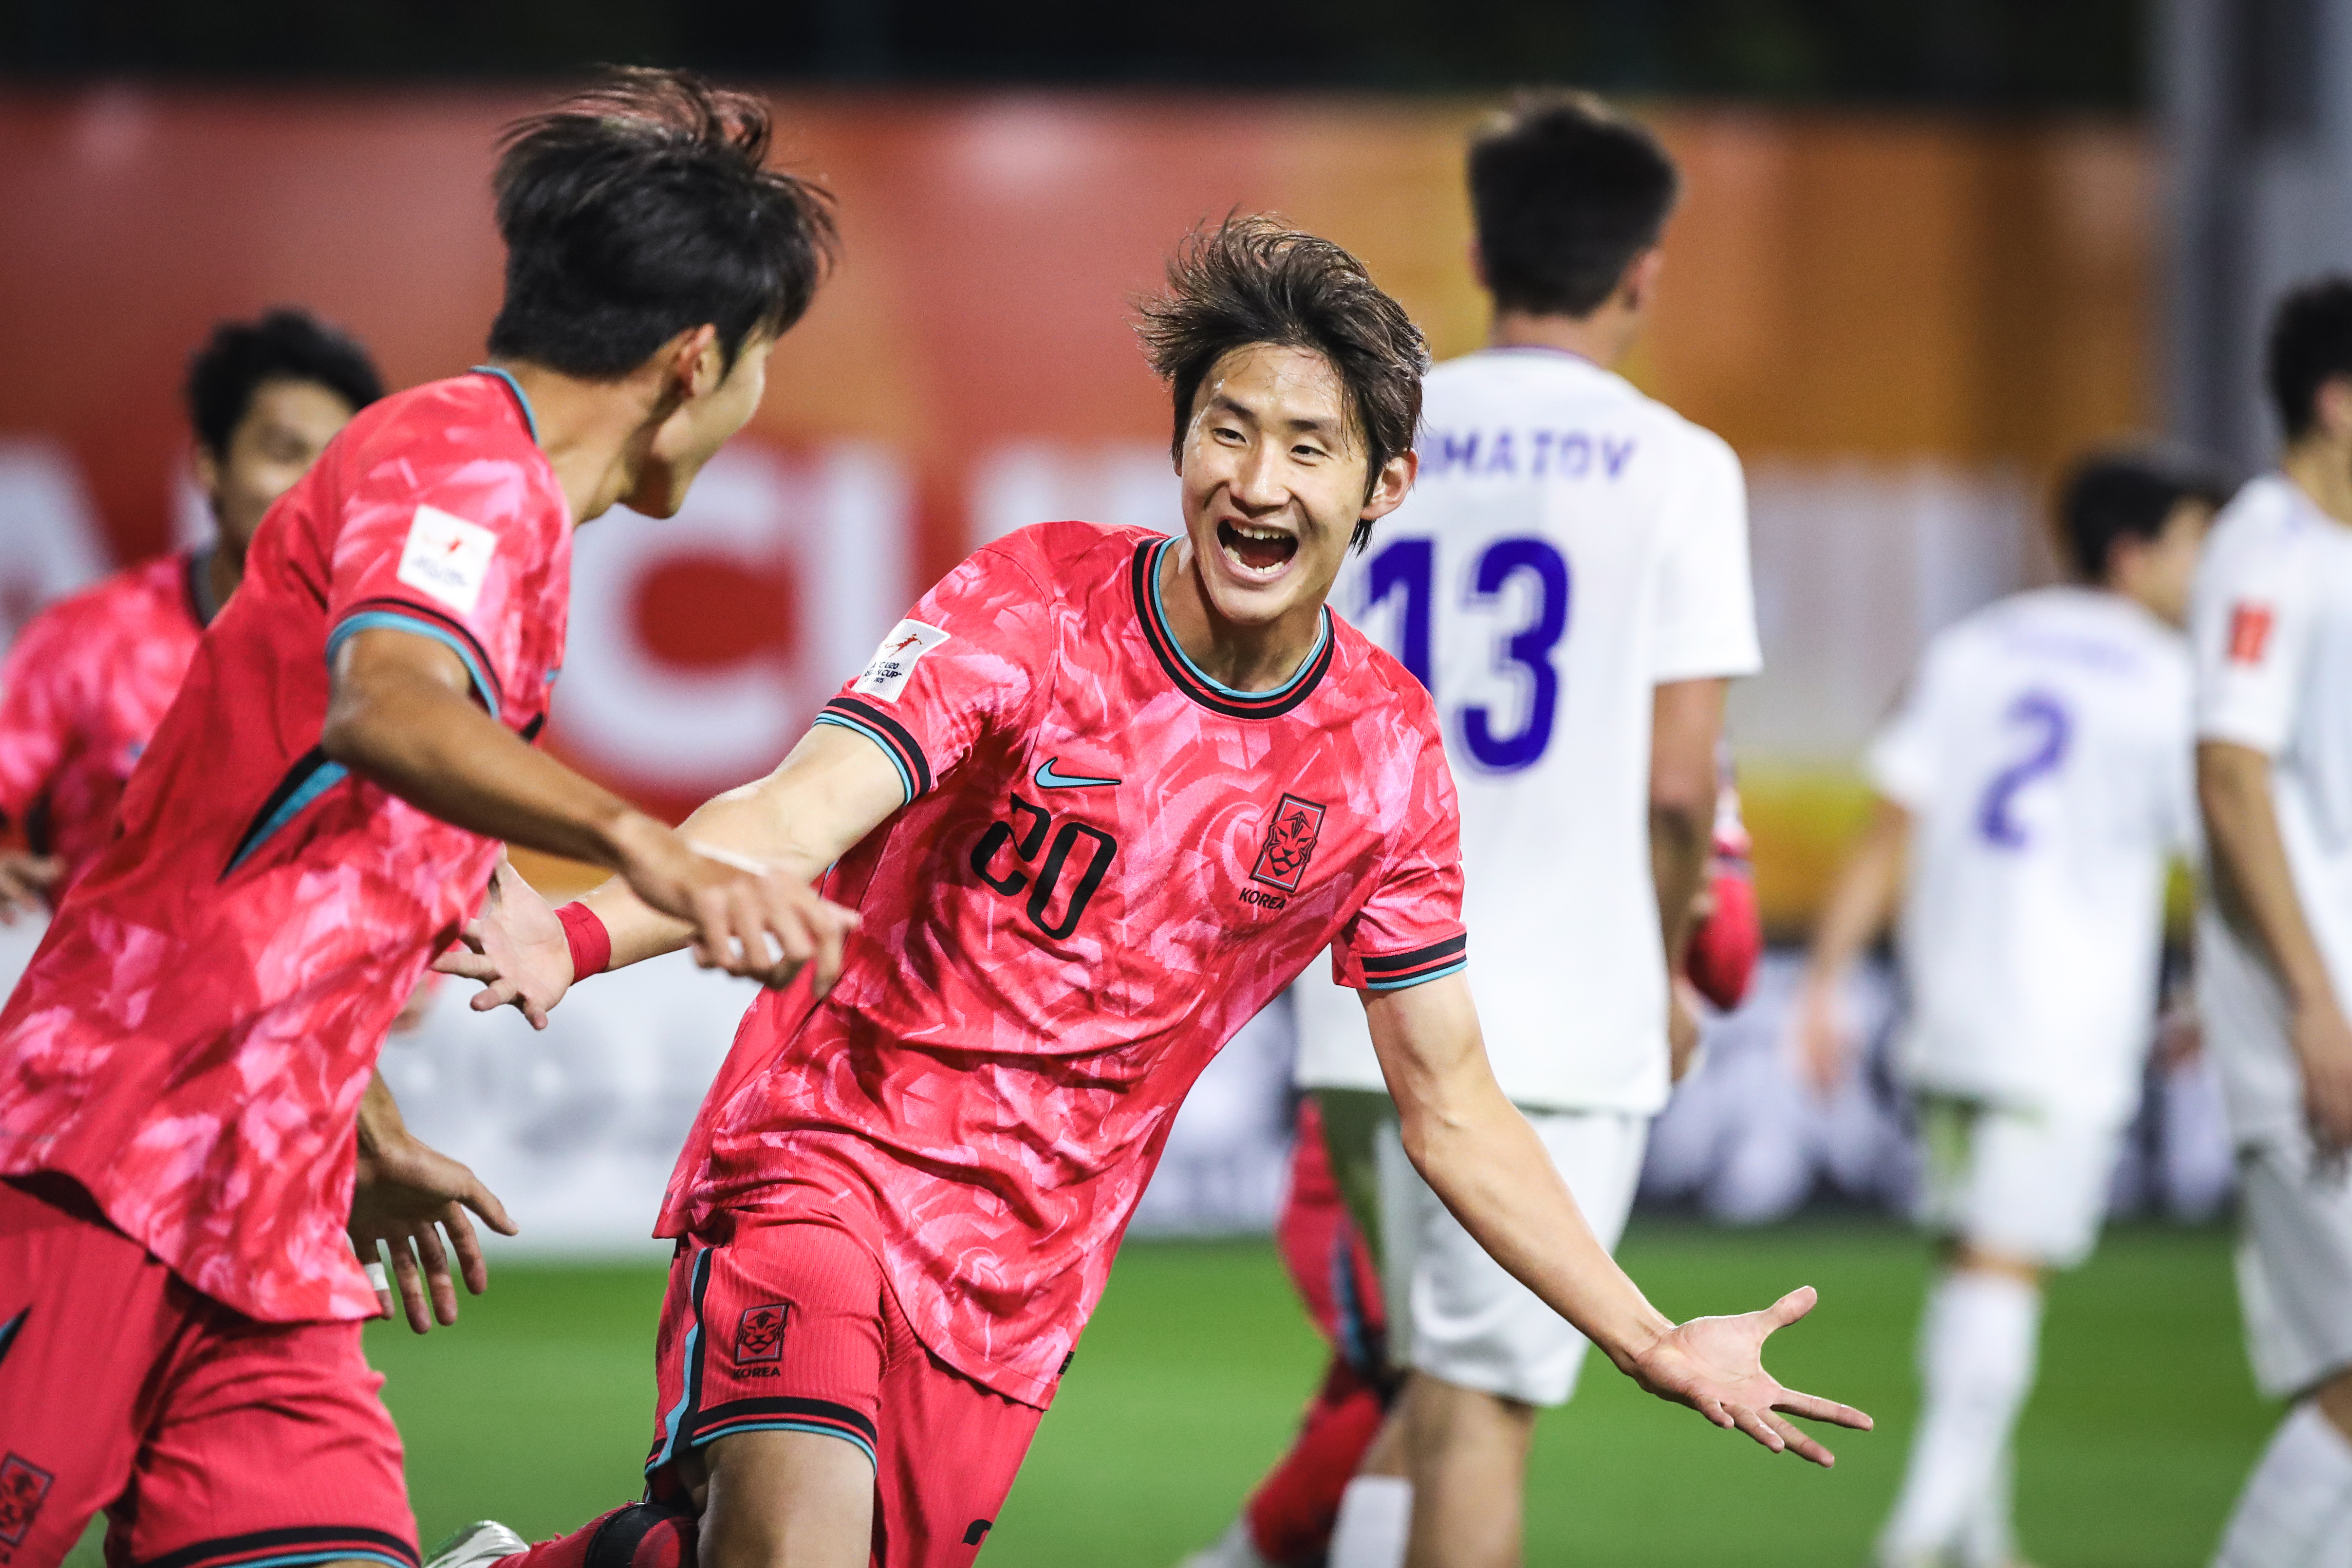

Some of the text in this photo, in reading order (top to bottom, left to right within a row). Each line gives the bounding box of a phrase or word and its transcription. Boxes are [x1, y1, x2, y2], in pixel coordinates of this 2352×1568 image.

[1356, 535, 1569, 774] 13
[1978, 689, 2073, 849] 2
[970, 792, 1117, 939] 20
[1238, 887, 1286, 910] KOREA
[733, 1366, 781, 1380] KOREA
